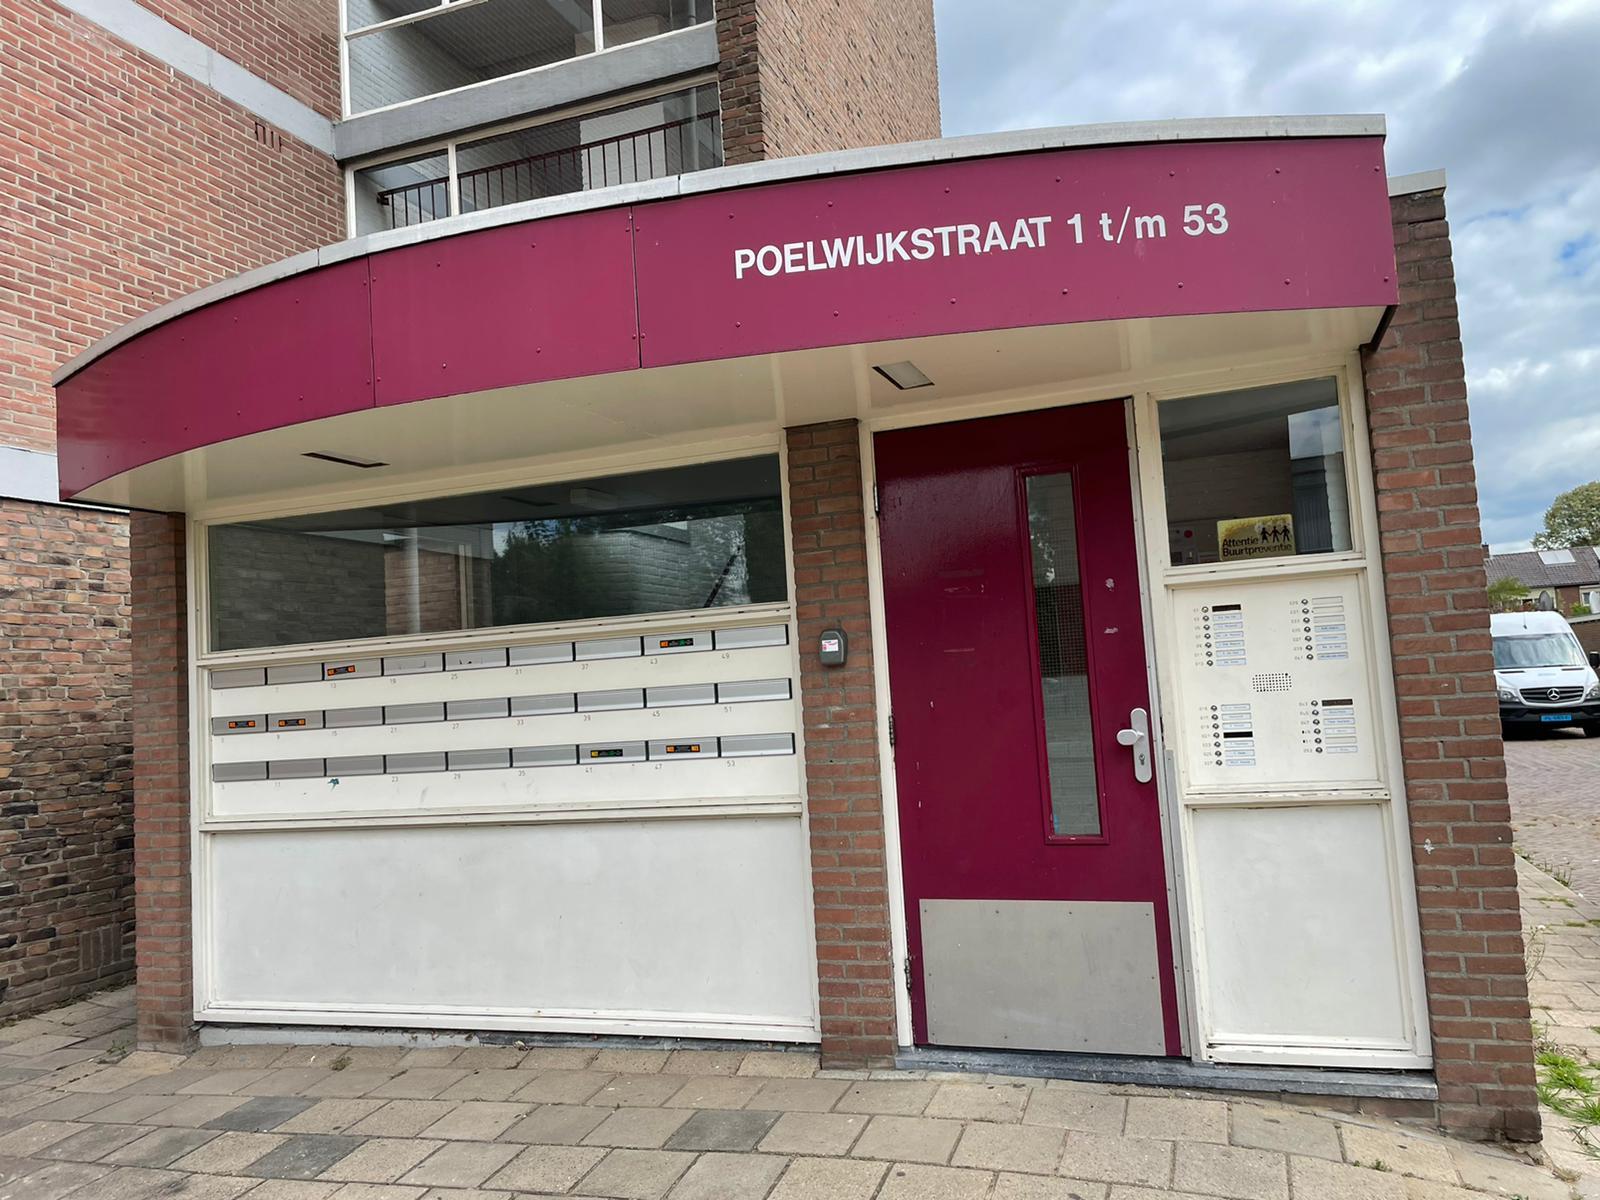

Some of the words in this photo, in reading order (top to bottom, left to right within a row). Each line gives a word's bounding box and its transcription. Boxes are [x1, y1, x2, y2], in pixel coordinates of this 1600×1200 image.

[734, 216, 1052, 279] POELWIJKSTRAAT
[1067, 213, 1084, 244] 1
[1098, 206, 1167, 244] t/m
[1182, 203, 1229, 236] 53
[1222, 536, 1259, 548] Attentie
[1222, 542, 1293, 557] Buurtpreventie
